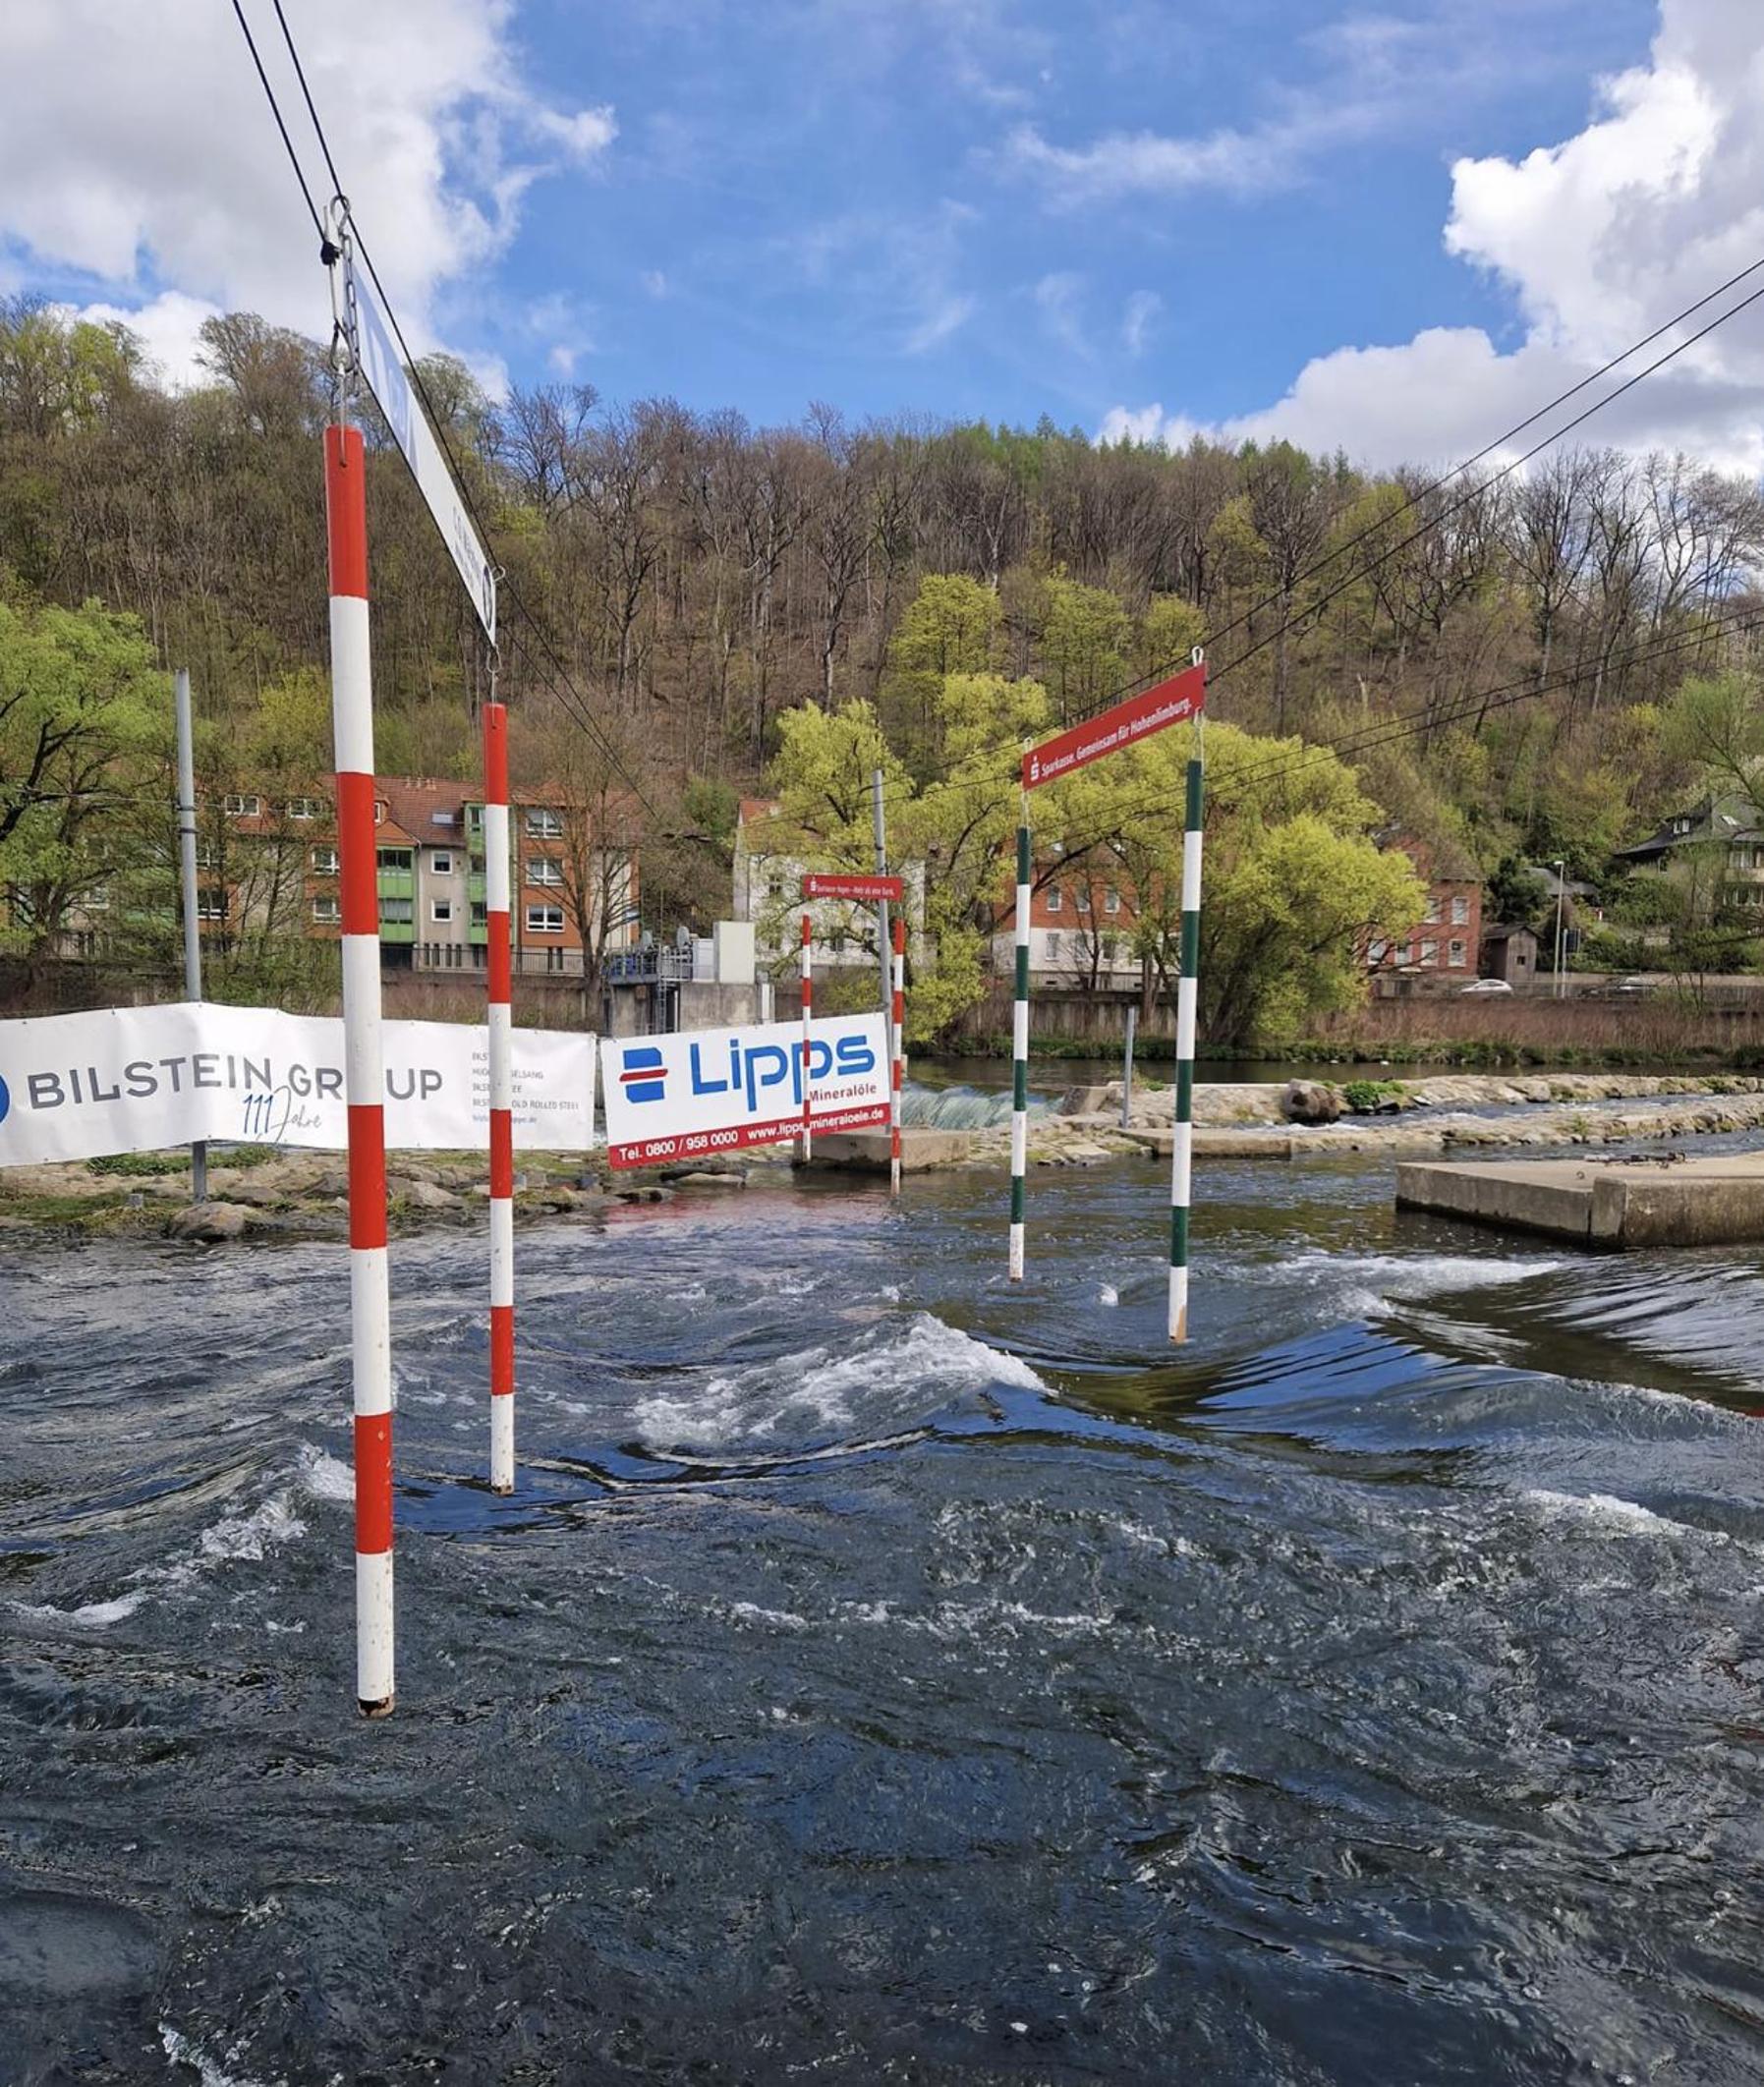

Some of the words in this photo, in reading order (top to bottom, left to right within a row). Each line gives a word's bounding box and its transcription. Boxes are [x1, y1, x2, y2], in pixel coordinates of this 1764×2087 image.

[1076, 732, 1118, 761] Gemeinsam
[1117, 724, 1130, 742] für
[1130, 698, 1192, 736] Hohenlimburg.
[28, 1053, 272, 1109] BILSTEIN
[288, 1063, 442, 1100] GRUP
[690, 1035, 876, 1112] Lipps
[809, 1084, 877, 1102] Mineralöle
[619, 1146, 643, 1161] Tel.
[646, 1140, 675, 1156] 0800
[686, 1134, 709, 1151] 958
[711, 1130, 739, 1146] 0000
[748, 1107, 884, 1141] www.lippsmineraloele.de
